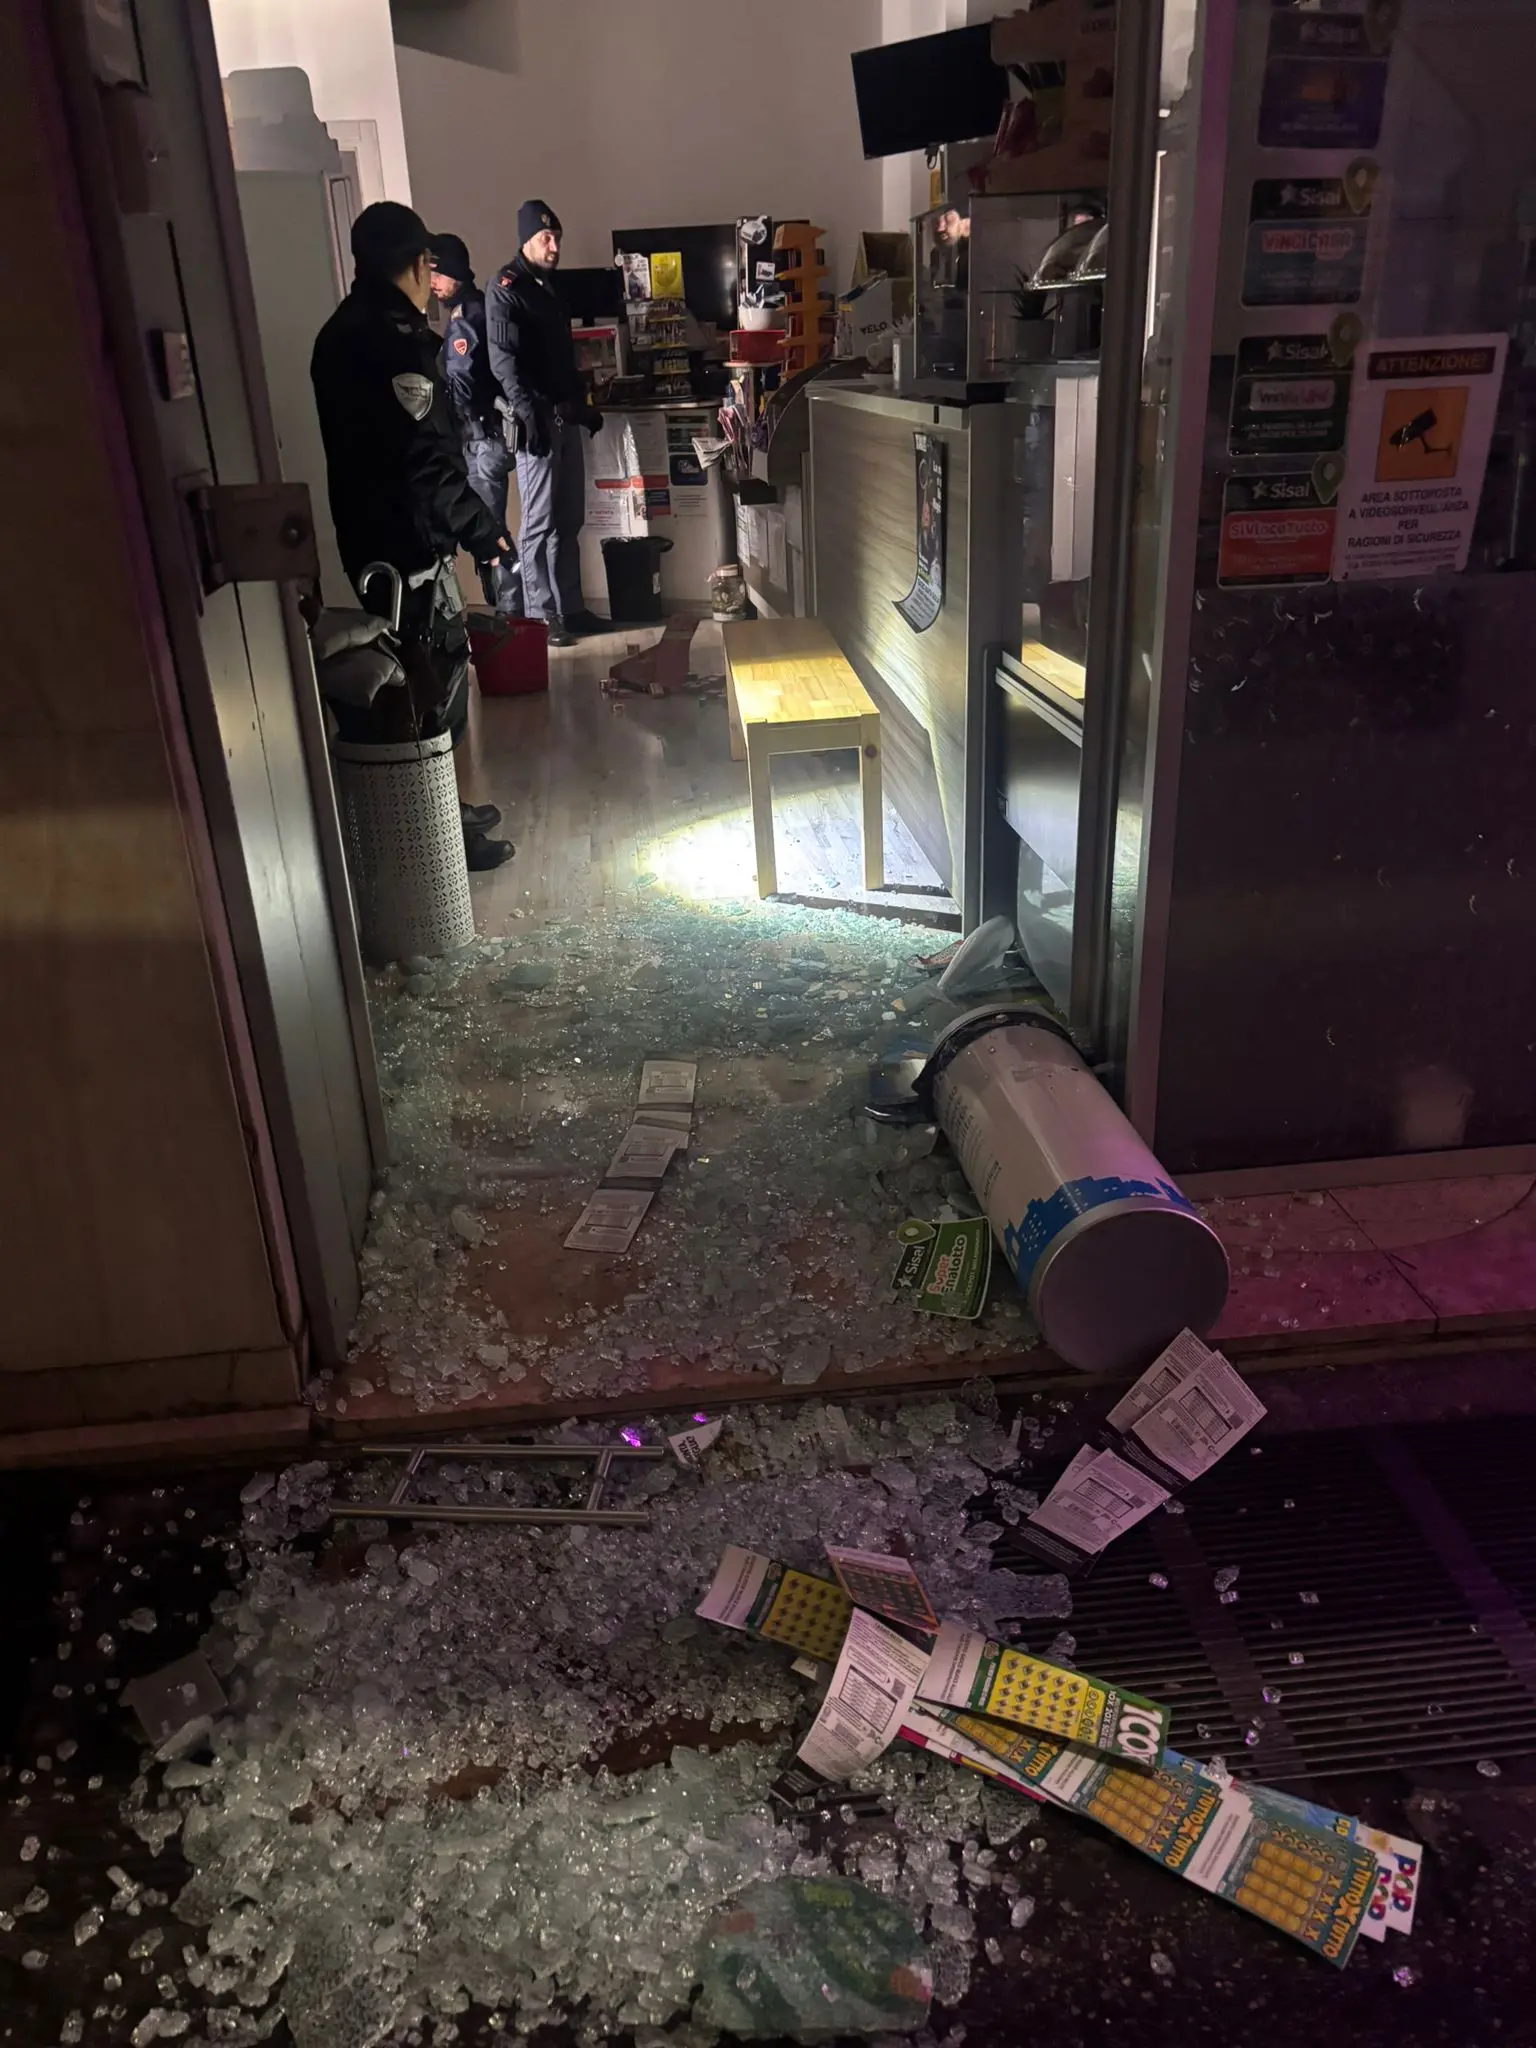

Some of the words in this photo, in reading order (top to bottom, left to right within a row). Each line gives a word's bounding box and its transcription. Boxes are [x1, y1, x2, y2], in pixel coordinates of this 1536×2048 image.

[1300, 186, 1341, 206] Sisal
[1286, 343, 1326, 360] Sisal
[1271, 481, 1311, 499] Sisal
[1348, 509, 1357, 520] A
[1398, 519, 1419, 531] PER
[1347, 535, 1391, 549] RAGIONI
[1393, 534, 1405, 545] DI
[1407, 529, 1462, 545] SICUREZZA
[904, 1244, 926, 1276] Sisal
[1190, 1794, 1217, 1826] TUTTO
[1178, 1815, 1204, 1838] X
[1164, 1836, 1192, 1867] TUTTO
[1344, 1868, 1373, 1907] TUTTO
[1391, 1852, 1418, 1913] POP
[1333, 1896, 1361, 1921] X
[1322, 1919, 1350, 1959] TUTTO
